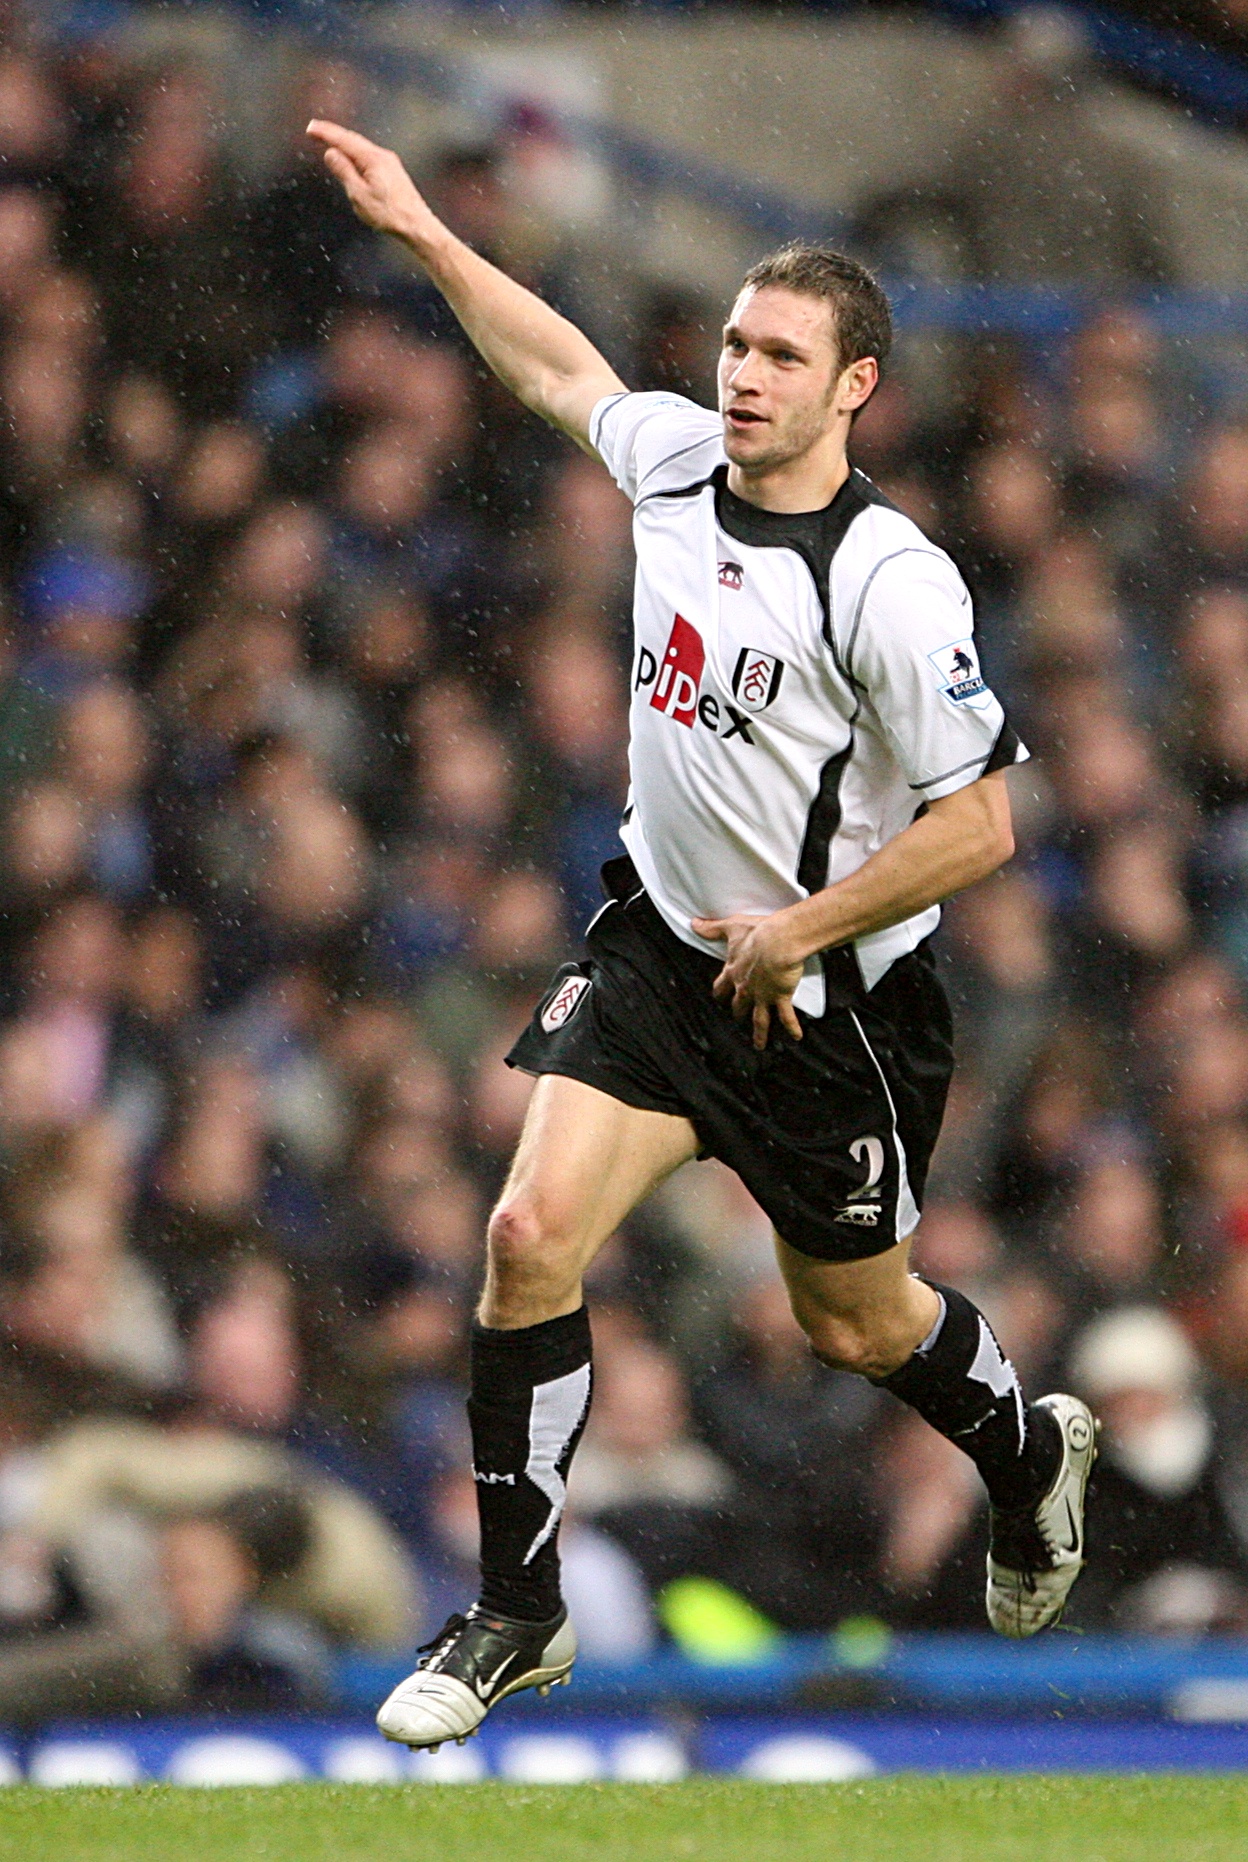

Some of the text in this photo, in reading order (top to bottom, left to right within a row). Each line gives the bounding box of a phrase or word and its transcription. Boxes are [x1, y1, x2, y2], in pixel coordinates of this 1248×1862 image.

[635, 645, 755, 746] pipex
[744, 659, 771, 702] FFC
[953, 679, 982, 696] BARCL
[847, 1134, 885, 1200] 2
